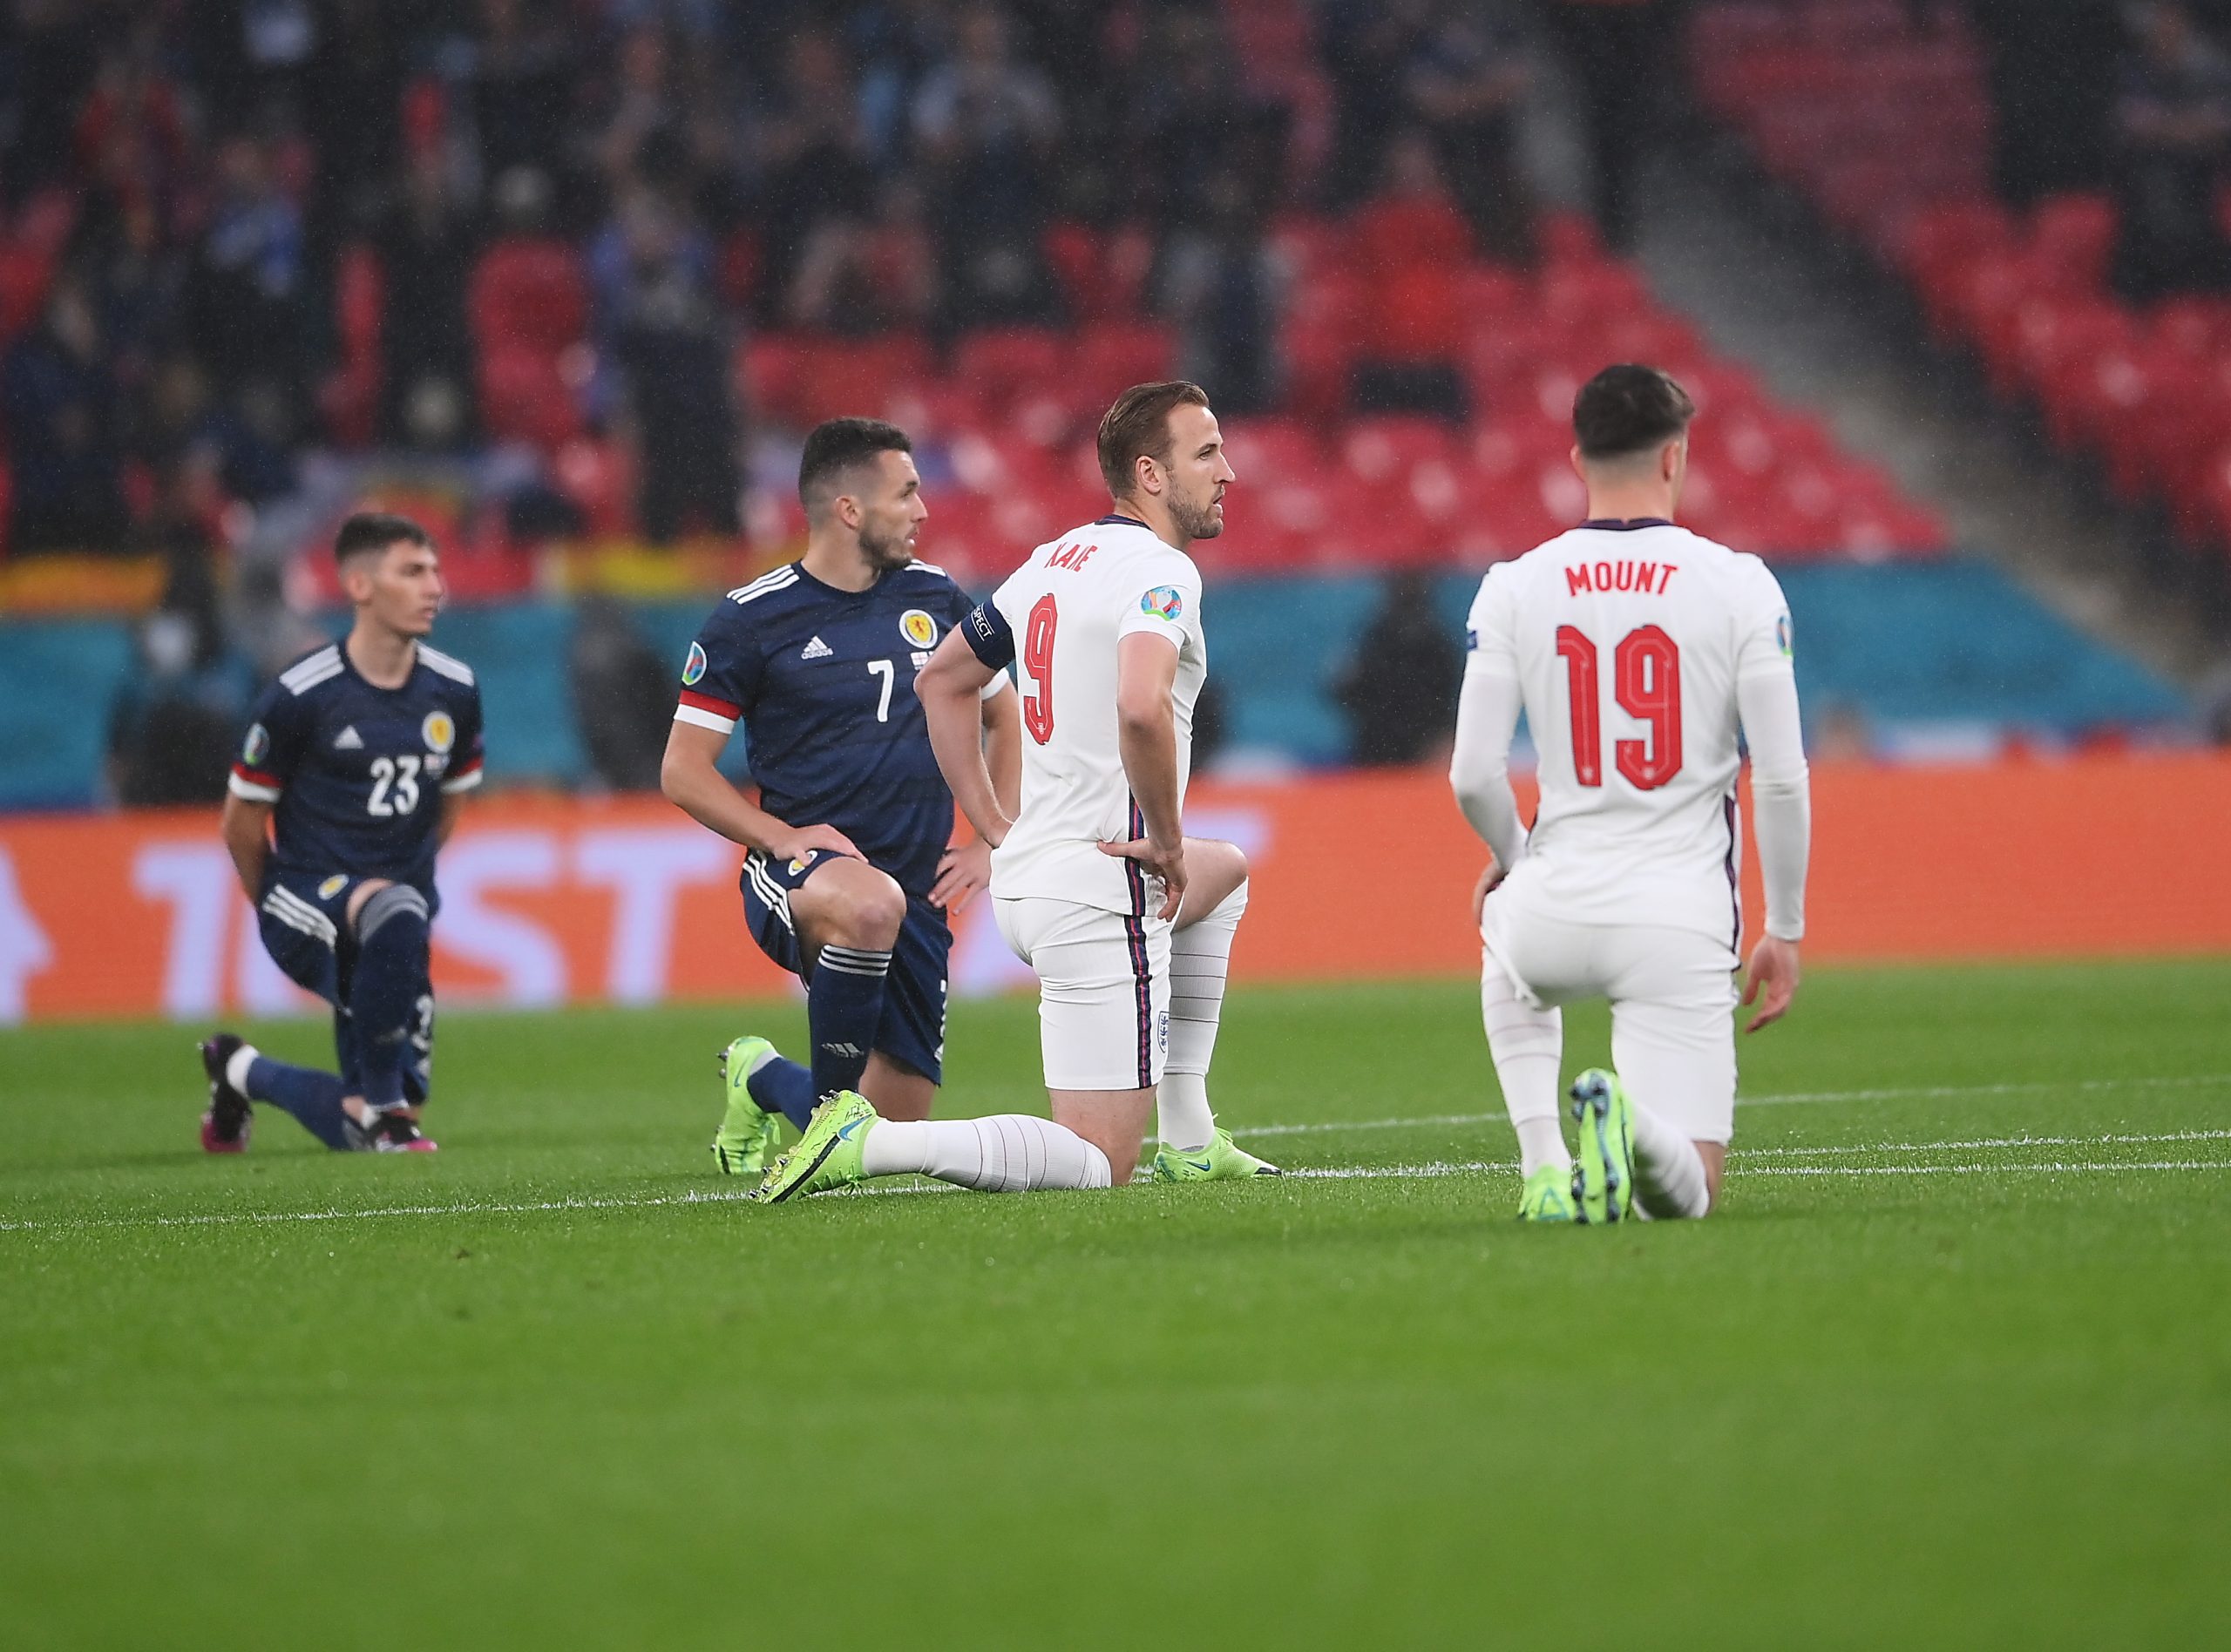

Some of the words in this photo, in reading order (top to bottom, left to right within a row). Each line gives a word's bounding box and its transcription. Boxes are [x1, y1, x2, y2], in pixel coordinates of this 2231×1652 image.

[1565, 560, 1678, 597] MOUNT
[867, 660, 894, 723] 7
[1024, 592, 1059, 747] 9
[1556, 625, 1683, 791] 19
[367, 755, 421, 816] 23
